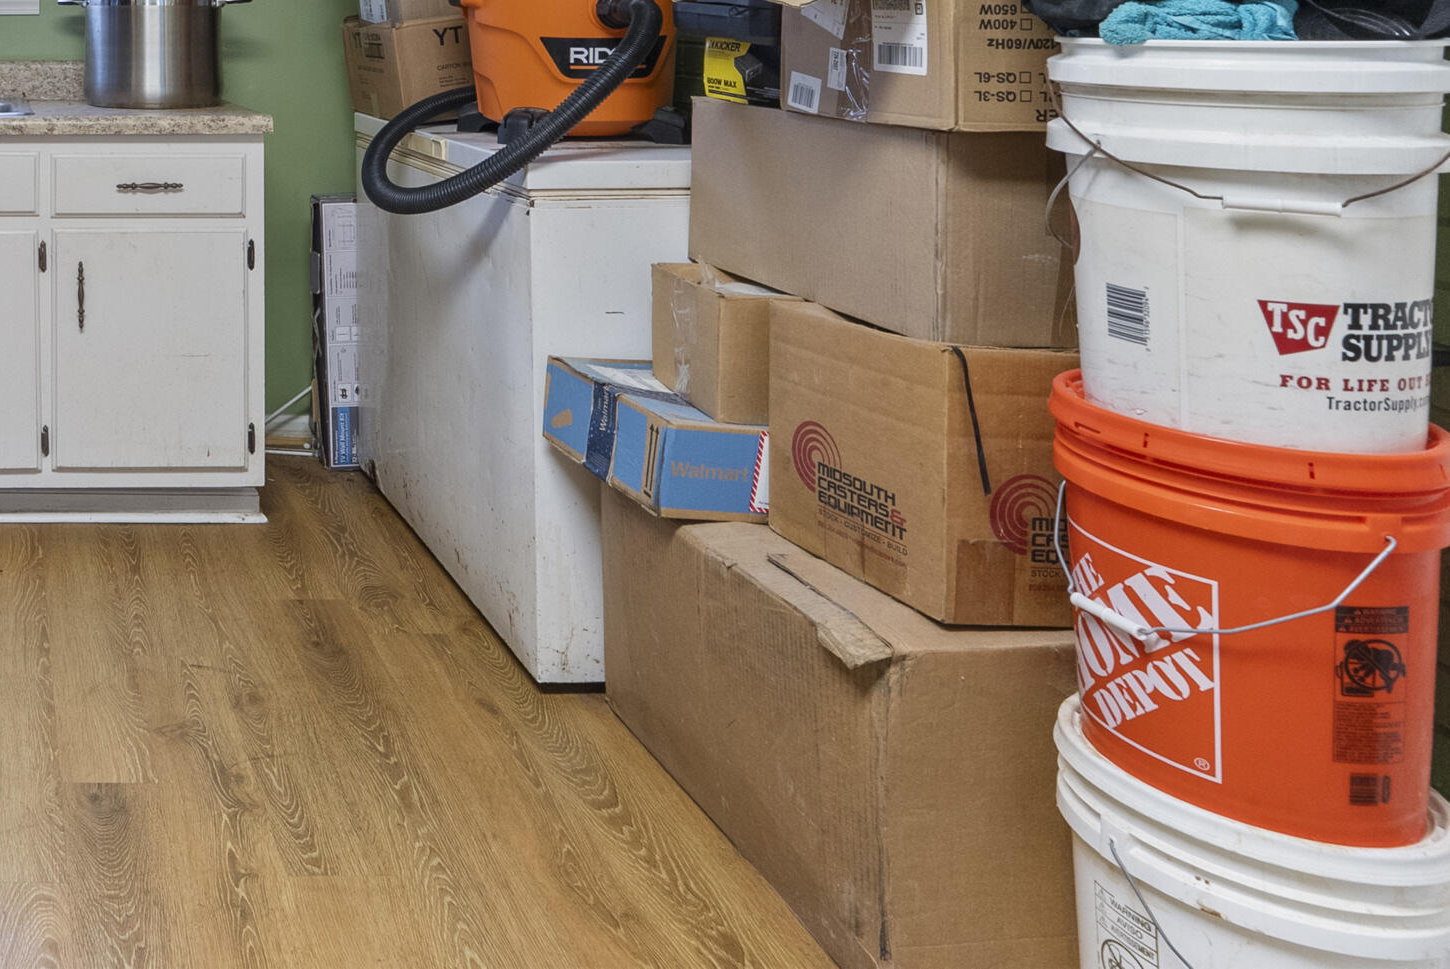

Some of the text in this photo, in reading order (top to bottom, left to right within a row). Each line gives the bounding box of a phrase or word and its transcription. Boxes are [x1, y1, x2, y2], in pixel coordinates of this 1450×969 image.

[979, 4, 1017, 15] 650W
[979, 19, 1017, 30] 400W
[714, 40, 741, 52] KICKER
[569, 47, 616, 64] RID
[723, 79, 737, 88] MAX
[974, 72, 1017, 84] QS-6L
[974, 90, 1017, 102] QS-3L
[1266, 302, 1326, 348] TSC
[1279, 375, 1330, 391] FOR
[1343, 378, 1389, 392] LIFE
[1398, 377, 1421, 391] OUT
[671, 460, 748, 482] Walmart
[817, 462, 896, 506] MIDSOUTH
[818, 476, 890, 518] CASTERS
[818, 491, 907, 540] EQUIPMENT
[1092, 647, 1216, 729] DEPOT
[1109, 897, 1151, 932] WARNING
